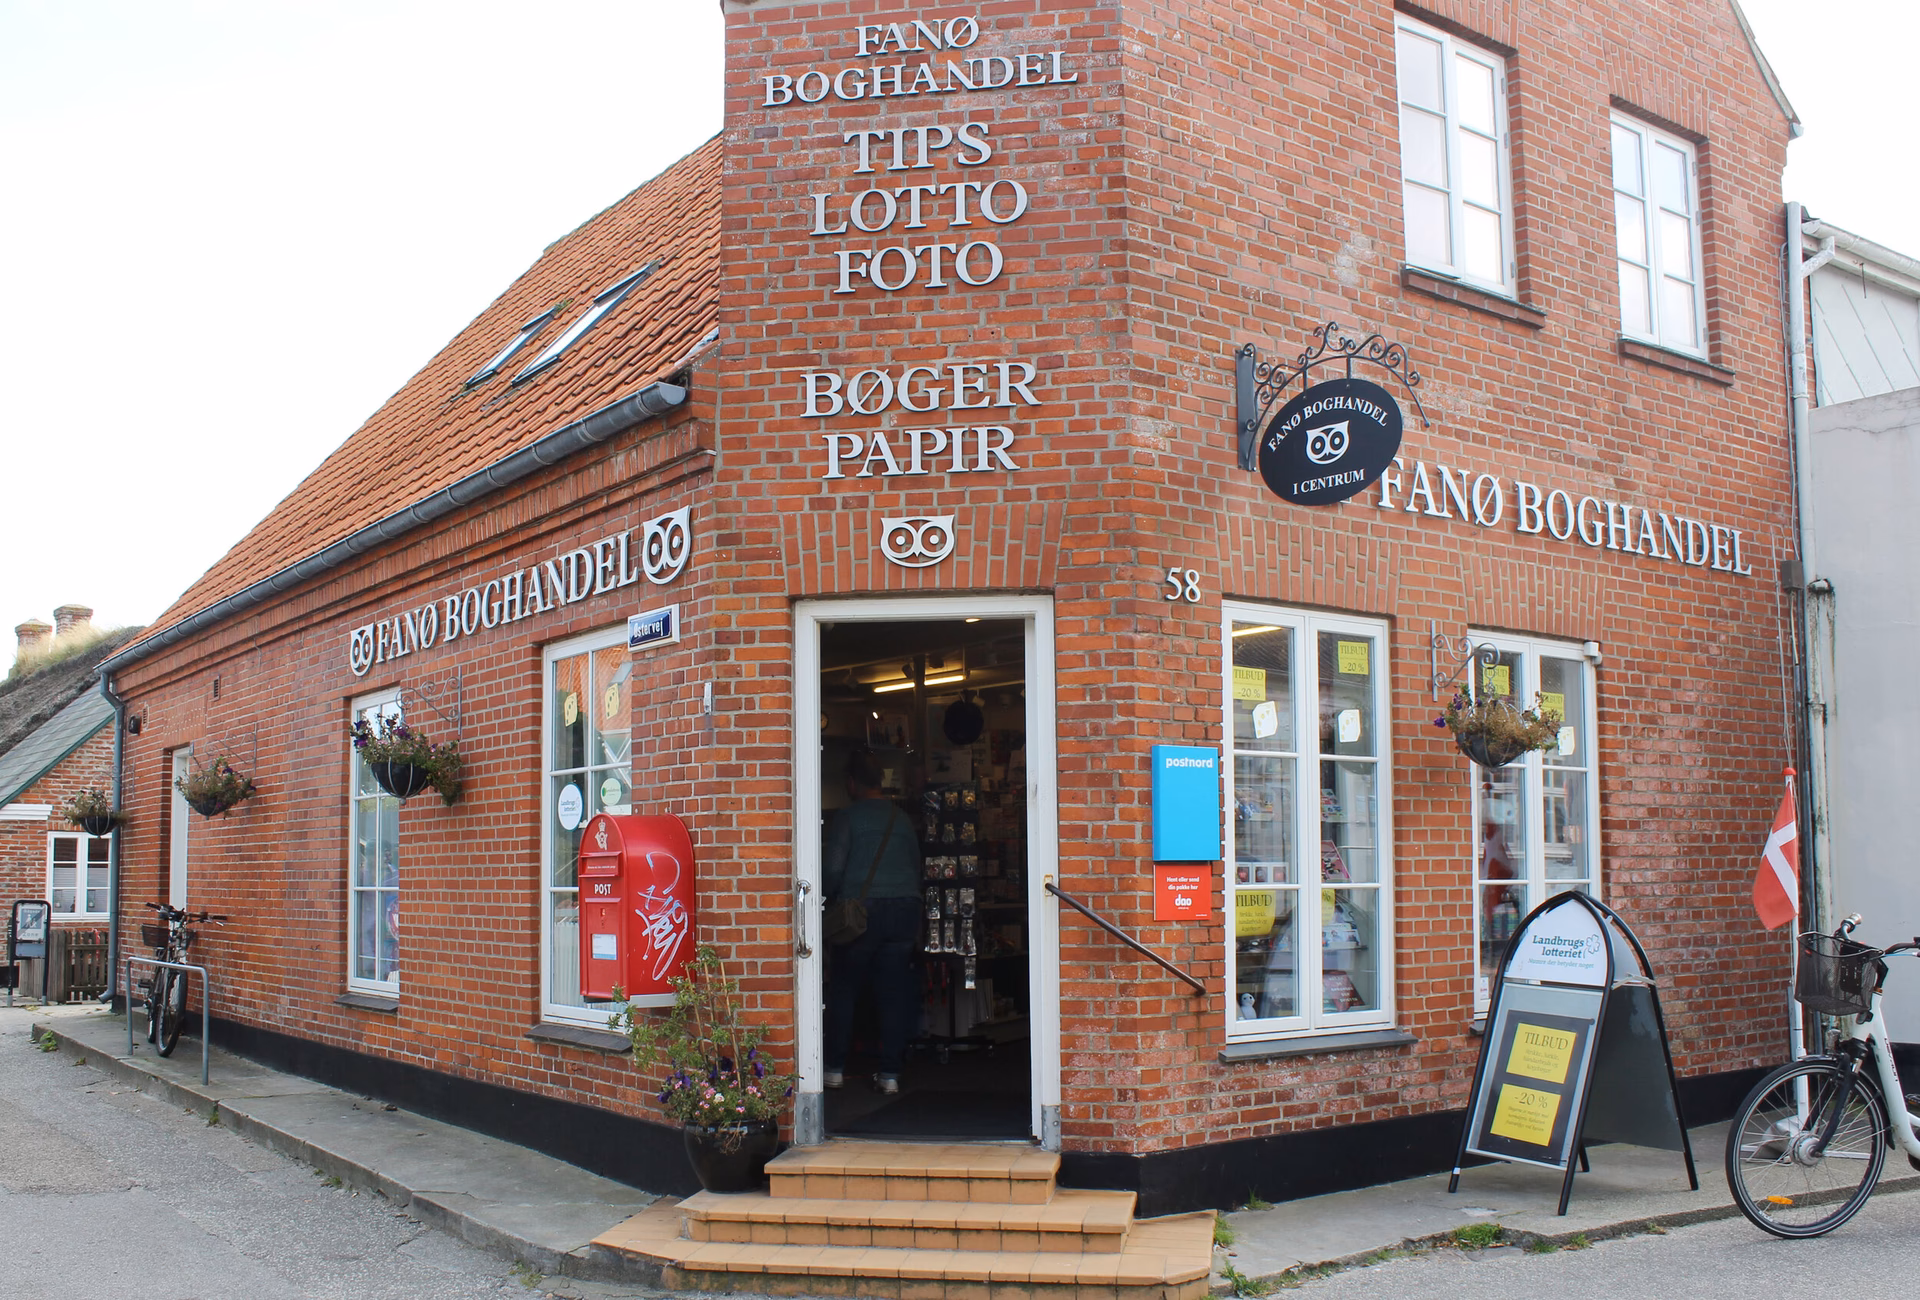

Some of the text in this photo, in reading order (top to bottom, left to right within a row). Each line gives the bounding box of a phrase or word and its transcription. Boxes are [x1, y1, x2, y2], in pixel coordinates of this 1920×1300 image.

[855, 15, 981, 57] FANØ
[762, 51, 1078, 107] BOGHANDEL
[844, 122, 992, 174] TIPS
[809, 179, 1028, 236] LOTTO
[833, 241, 1003, 294] FOTO
[800, 362, 1042, 418] BØGER
[1267, 396, 1388, 452] FANØ BOGHANDEL
[822, 426, 1021, 479] PAPIR
[1292, 468, 1366, 495] I CENTRUM
[1377, 456, 1753, 576] FANØ BOGHANDEL
[375, 531, 639, 664] FANØ BOGHANDEL
[1165, 566, 1202, 603] 58
[633, 617, 664, 638] Østervej
[1340, 645, 1368, 656] TILBUD
[1234, 669, 1264, 681] TILBUD
[1165, 757, 1214, 769] postnord
[594, 883, 612, 896] POST
[1175, 893, 1192, 907] dao
[1236, 894, 1272, 907] TILBUD
[1532, 935, 1585, 949] Landbrugs
[1541, 946, 1583, 959] lotteriet
[1524, 1031, 1569, 1050] TILBUD
[1514, 1092, 1548, 1109] -20 %
